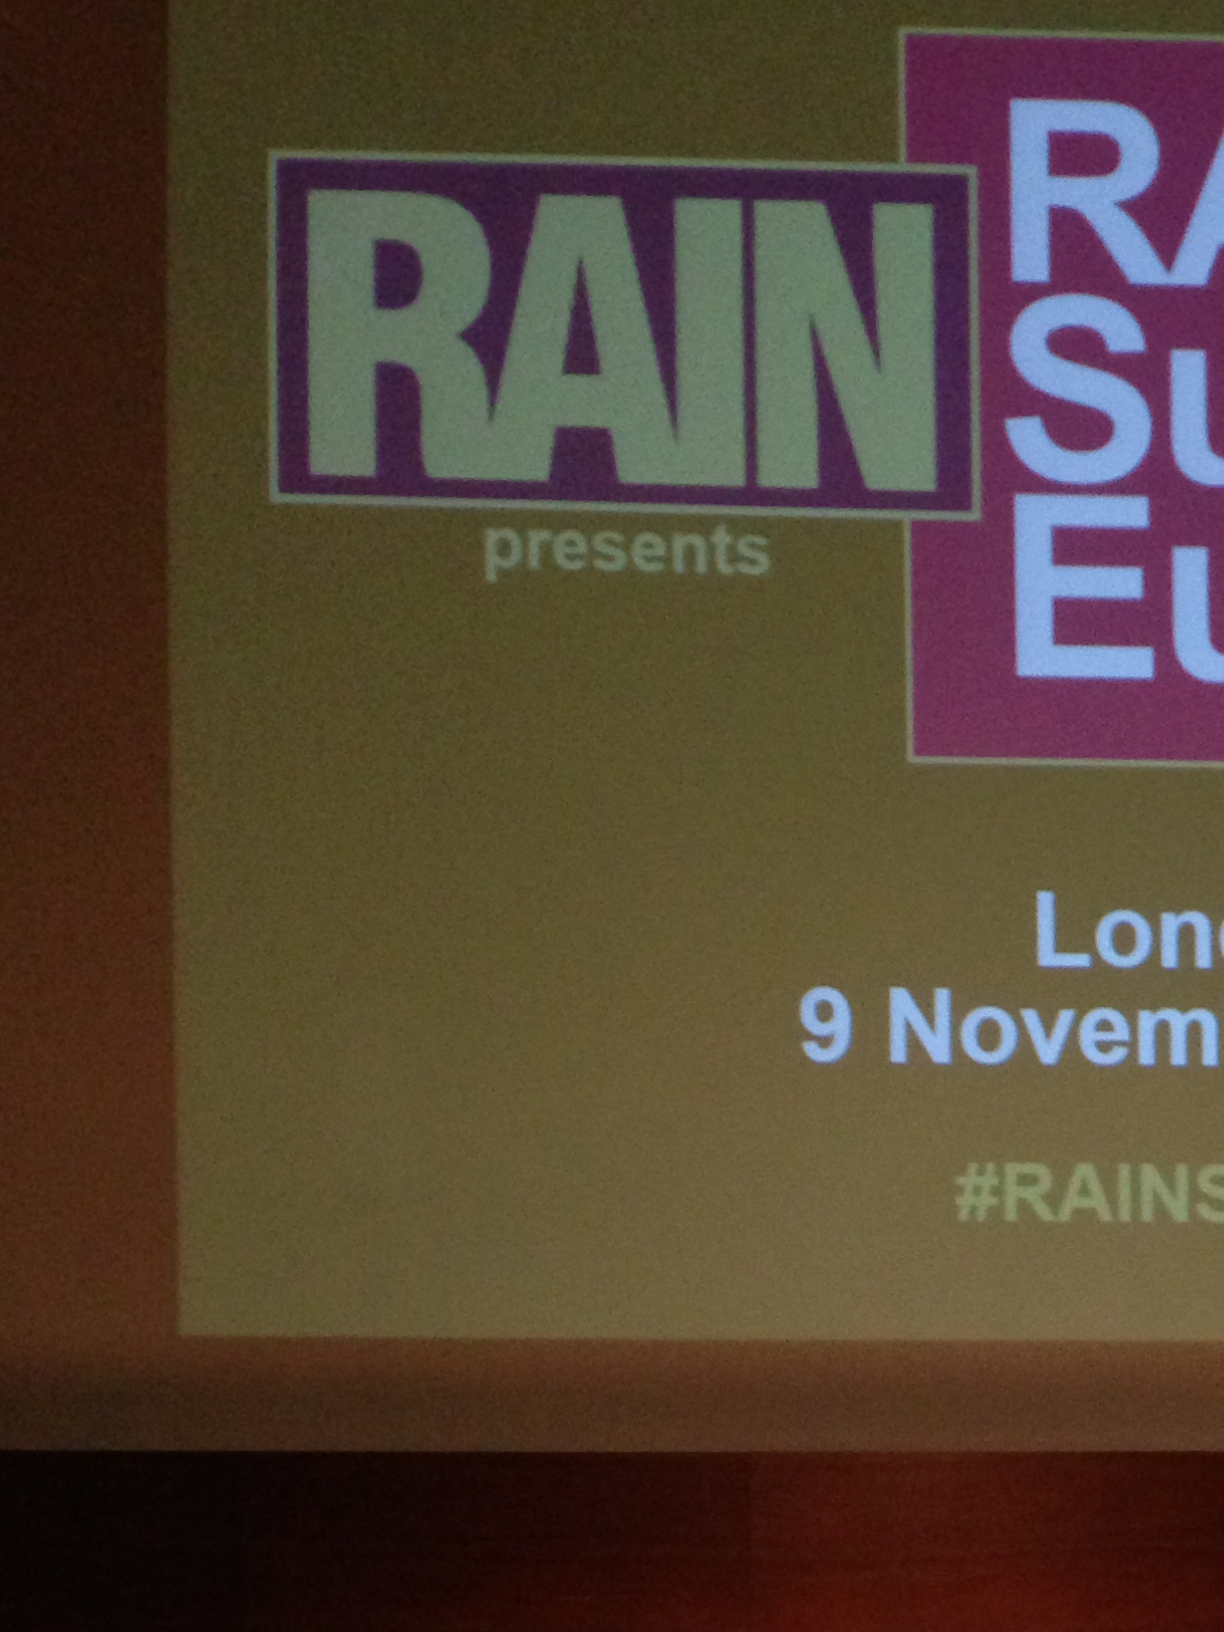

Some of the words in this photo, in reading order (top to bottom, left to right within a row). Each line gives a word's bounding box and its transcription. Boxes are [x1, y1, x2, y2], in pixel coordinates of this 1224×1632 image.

[307, 188, 937, 492] RAIN
[484, 523, 770, 582] presents
[799, 986, 852, 1064] 9
